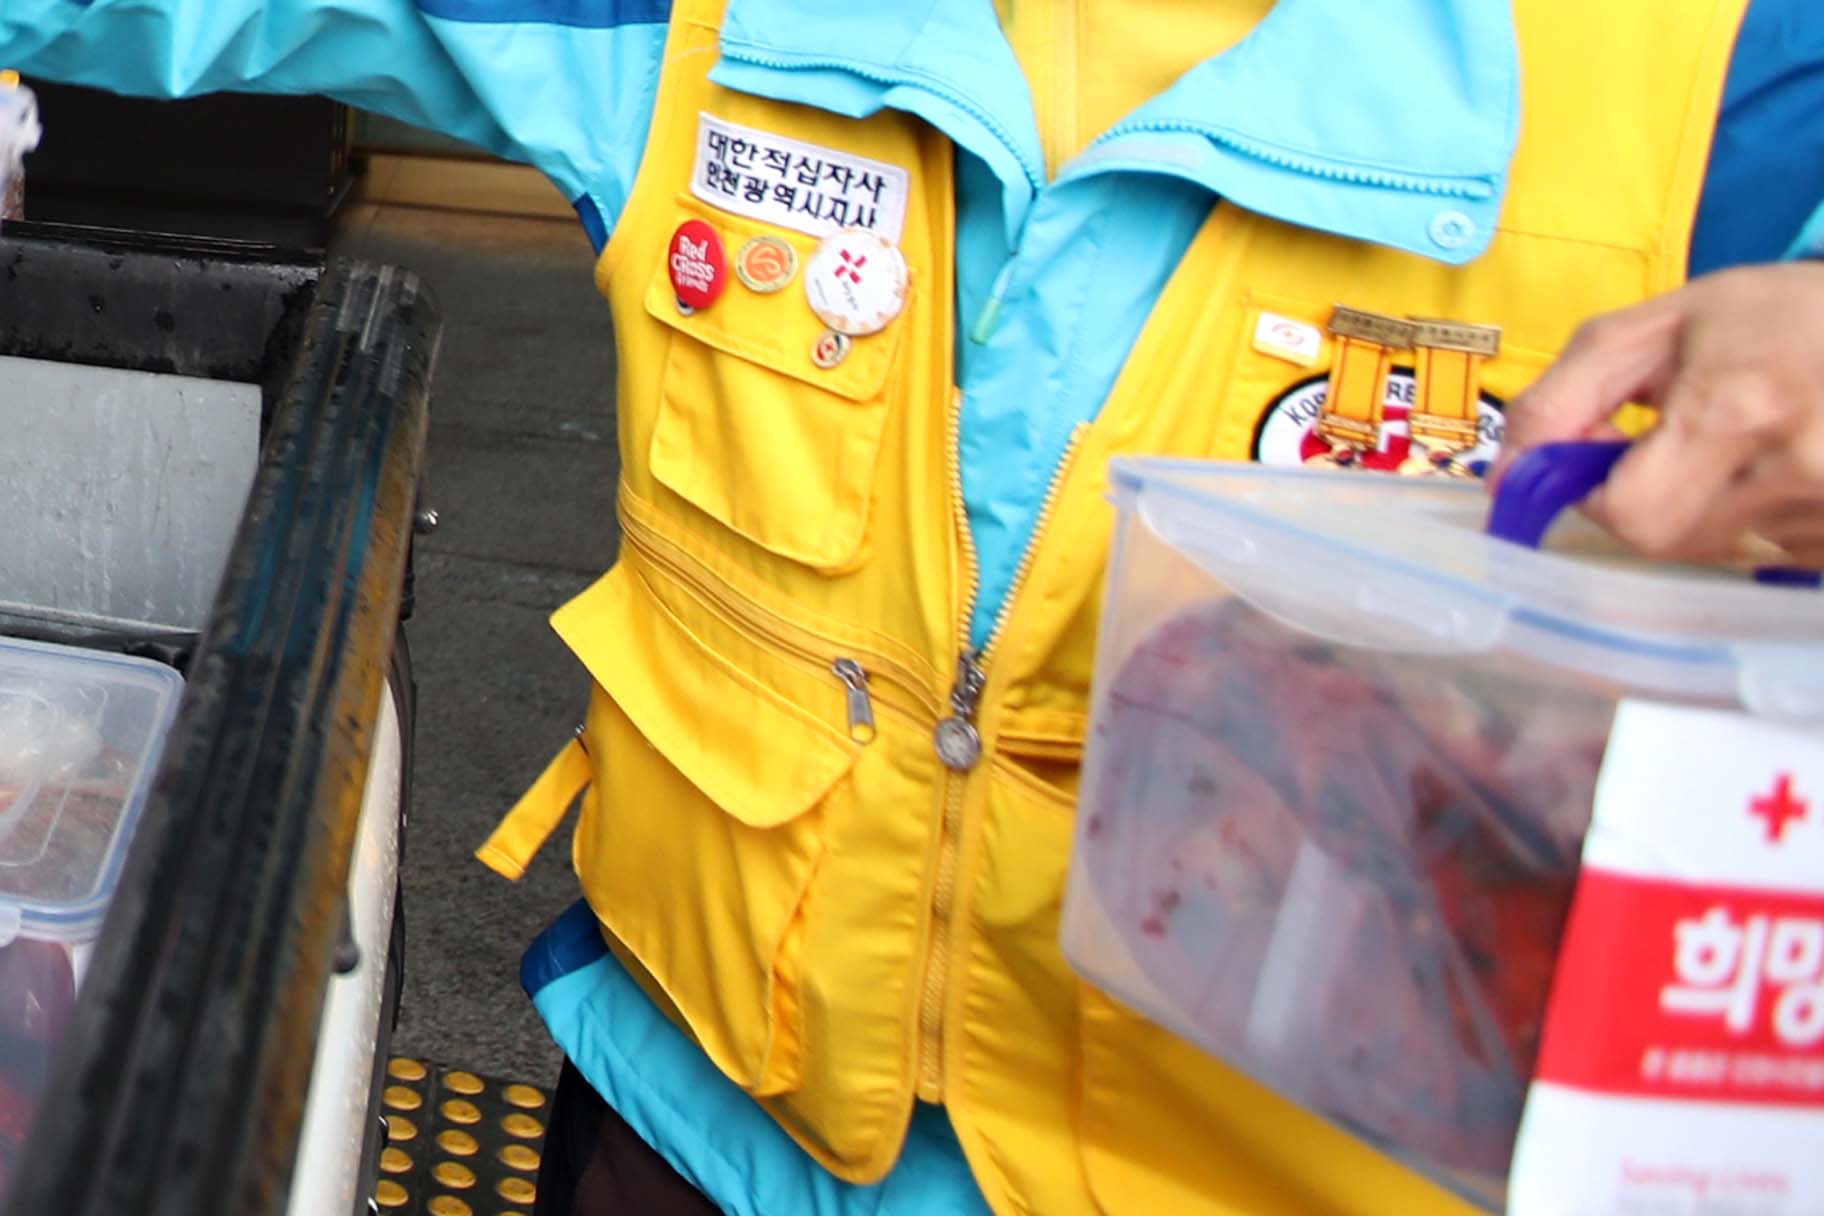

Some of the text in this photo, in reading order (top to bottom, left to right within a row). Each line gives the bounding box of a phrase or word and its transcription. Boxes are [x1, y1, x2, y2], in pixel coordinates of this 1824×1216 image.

[706, 161, 878, 230] 인천광역시지사
[707, 129, 887, 203] 대한적십자사
[679, 234, 709, 262] Red
[1282, 381, 1416, 428] KOR RE
[1659, 906, 1824, 1048] 희망
